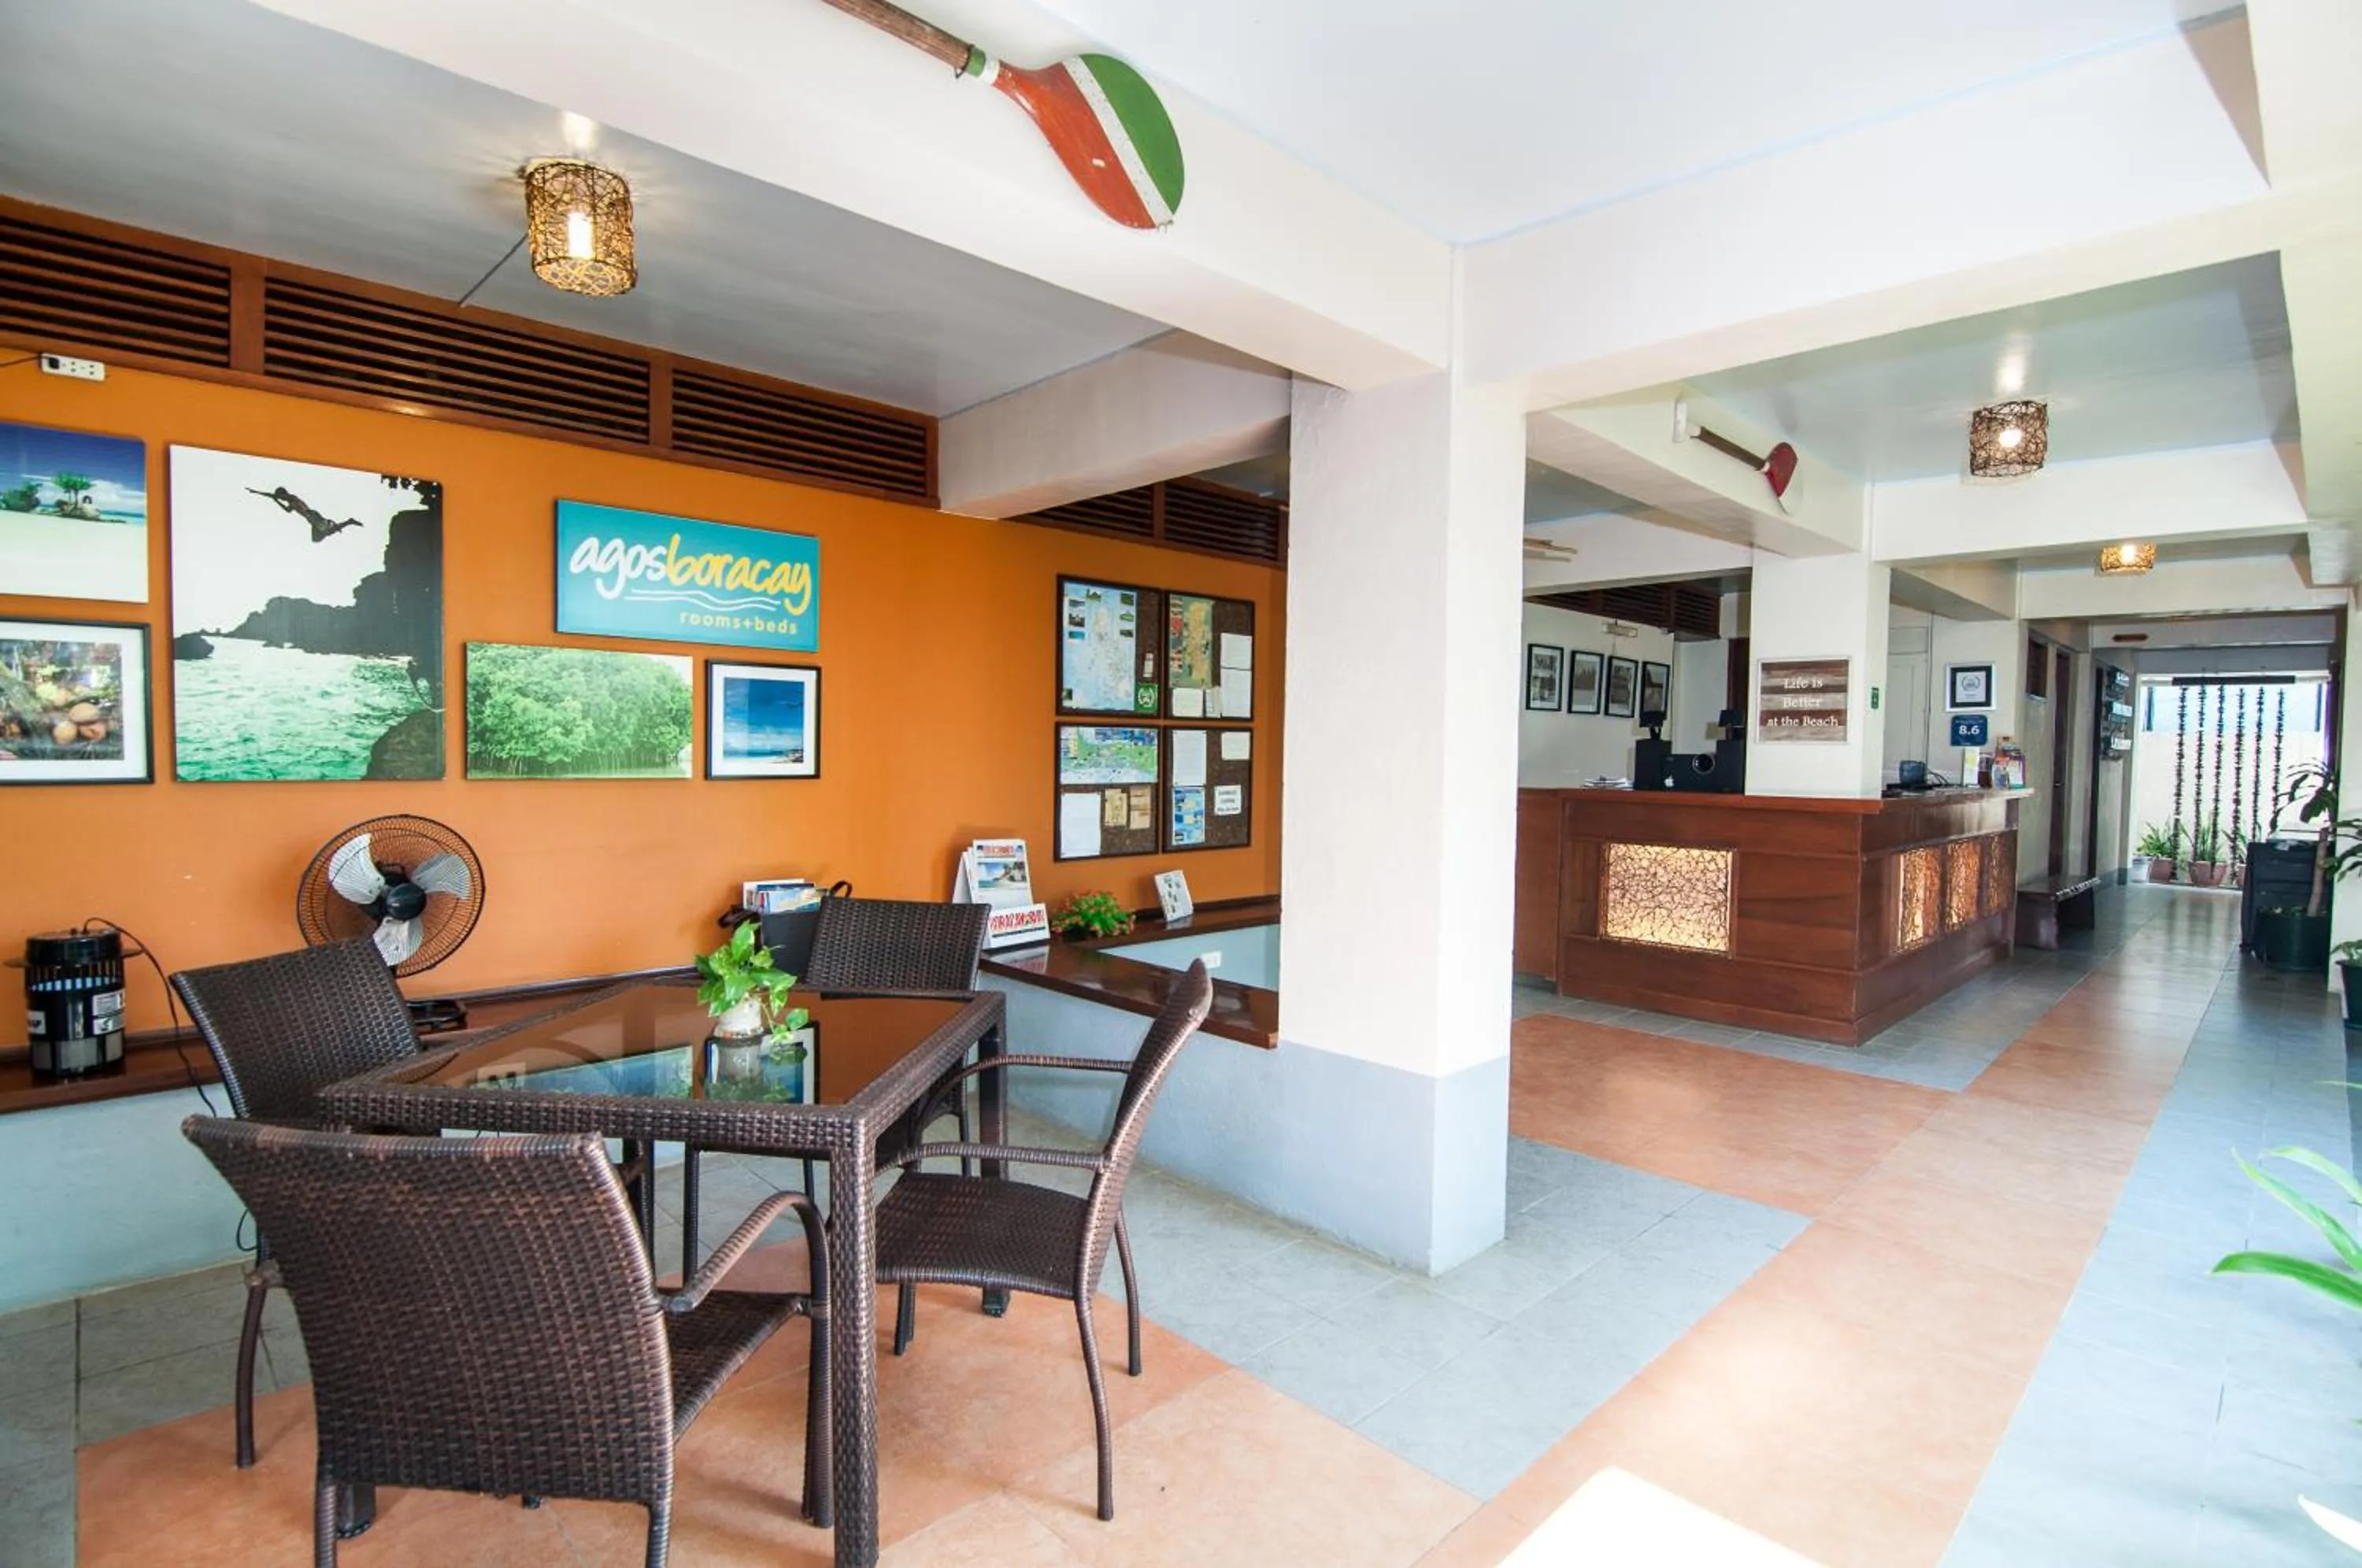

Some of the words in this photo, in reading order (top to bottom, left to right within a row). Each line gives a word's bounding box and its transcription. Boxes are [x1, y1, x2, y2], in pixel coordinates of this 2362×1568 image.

[679, 611, 798, 635] rooms+beds
[1783, 677, 1809, 689] Life
[1783, 697, 1822, 708] Better
[1767, 717, 1779, 727] at
[1781, 716, 1800, 727] the
[1802, 715, 1839, 727] Beach
[1958, 725, 1980, 735] 8.6
